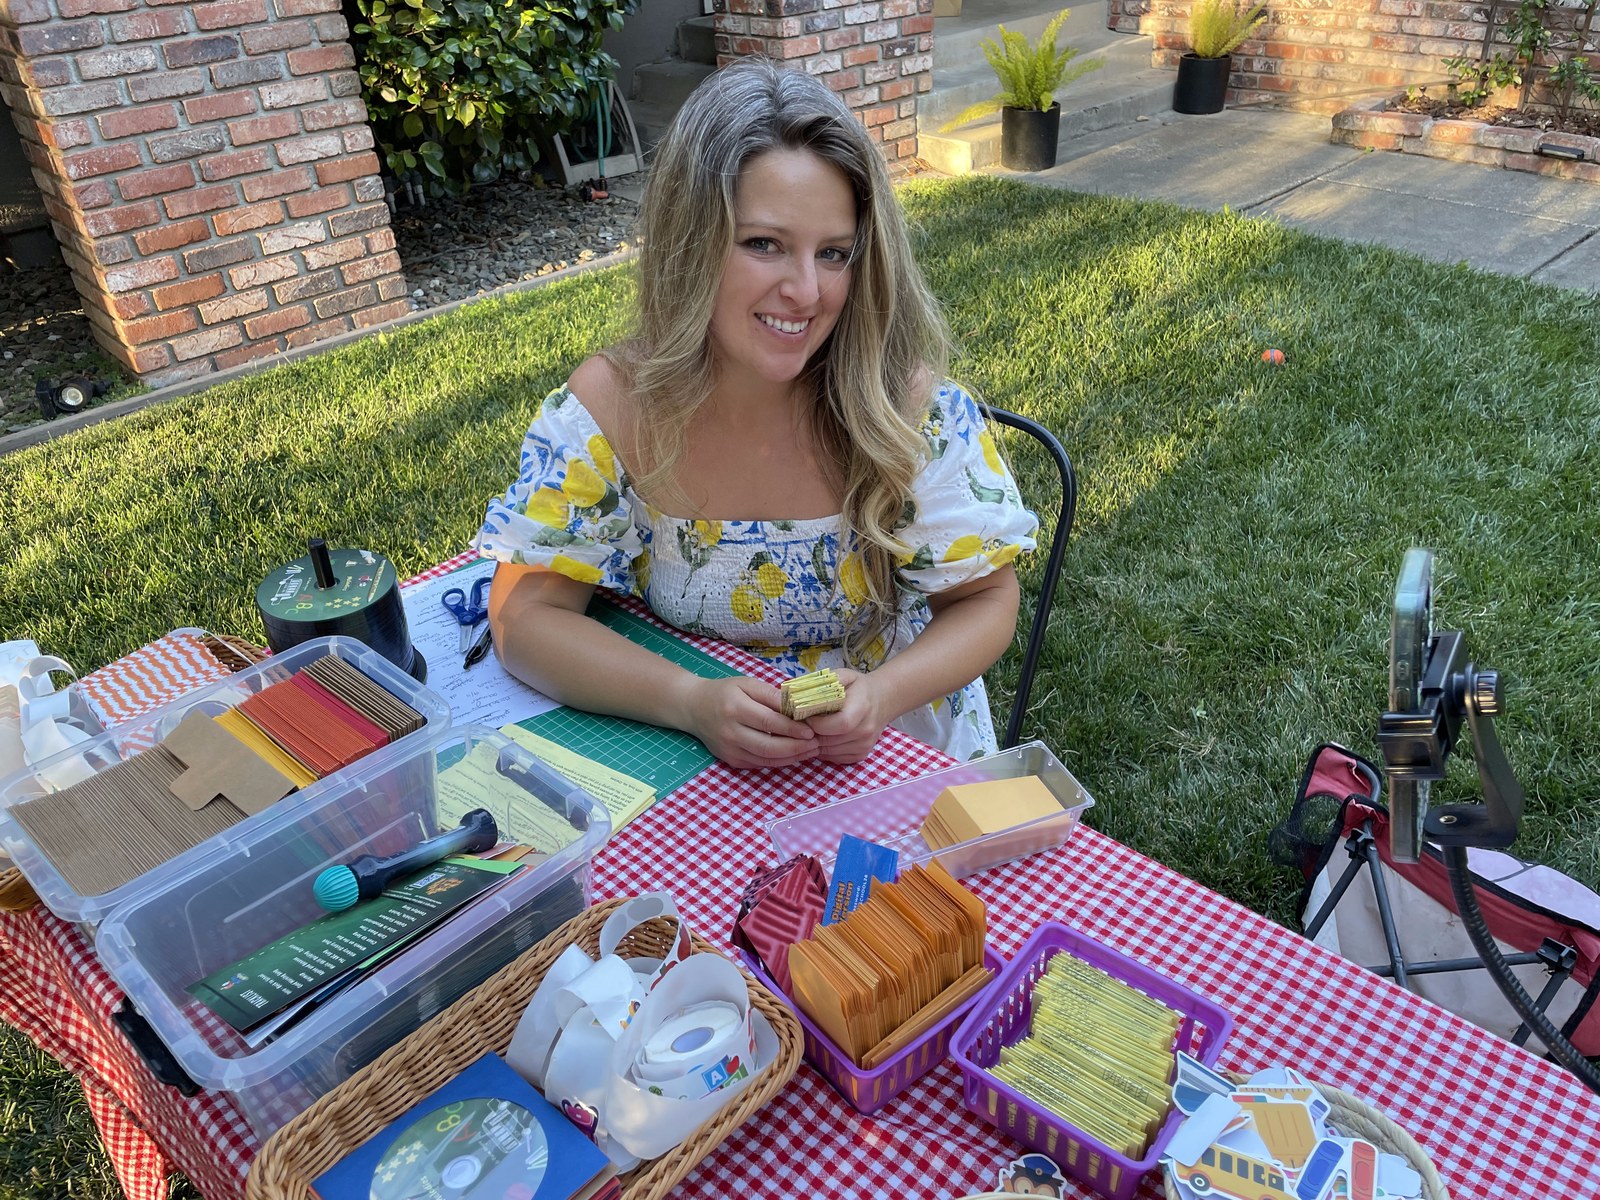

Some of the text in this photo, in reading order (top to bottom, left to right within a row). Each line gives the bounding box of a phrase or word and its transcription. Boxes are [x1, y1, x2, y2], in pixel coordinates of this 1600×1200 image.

[832, 881, 846, 920] Digital
[240, 989, 269, 1007] TRACKLIST
[710, 1070, 724, 1086] A
